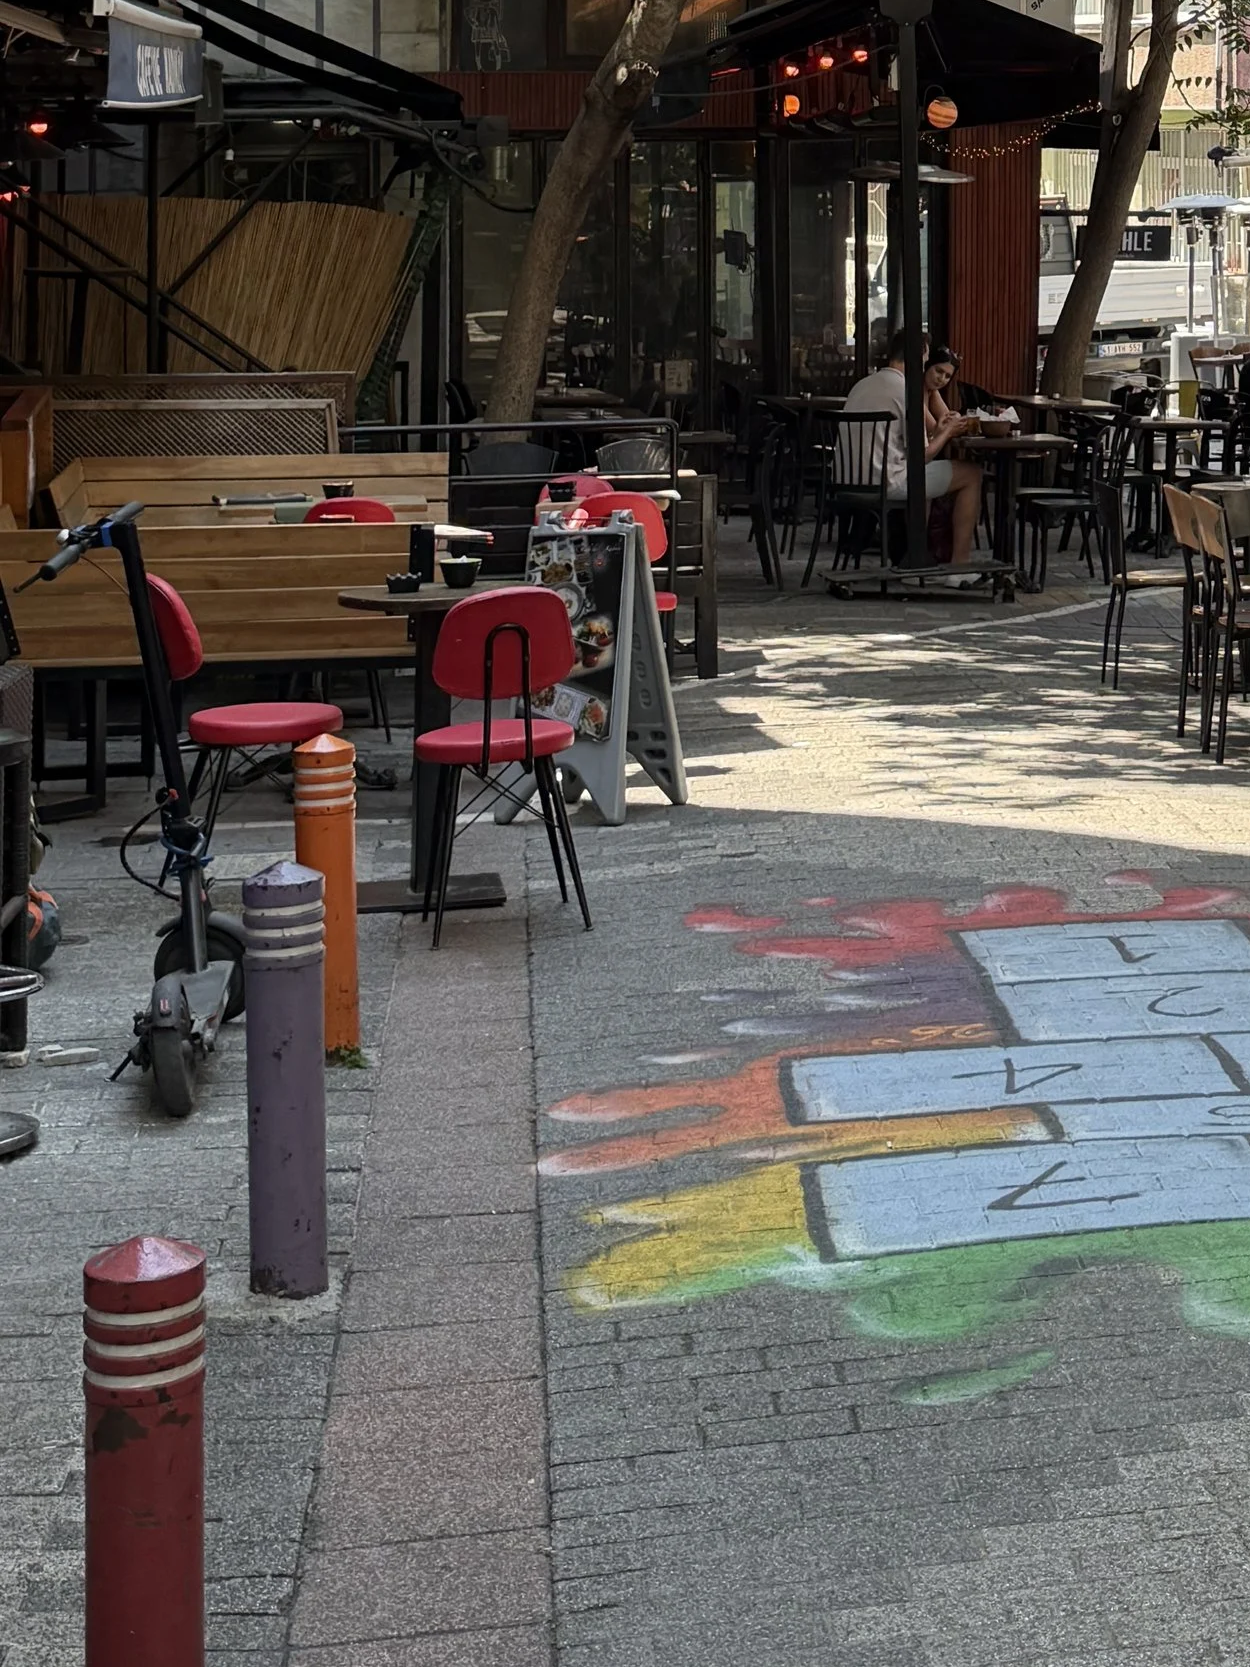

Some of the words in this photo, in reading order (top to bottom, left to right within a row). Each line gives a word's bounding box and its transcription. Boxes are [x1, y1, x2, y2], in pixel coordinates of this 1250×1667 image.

[1072, 933, 1158, 964] 1
[1105, 985, 1224, 1017] 2
[951, 1058, 1084, 1095] 4
[986, 1160, 1142, 1210] 7
